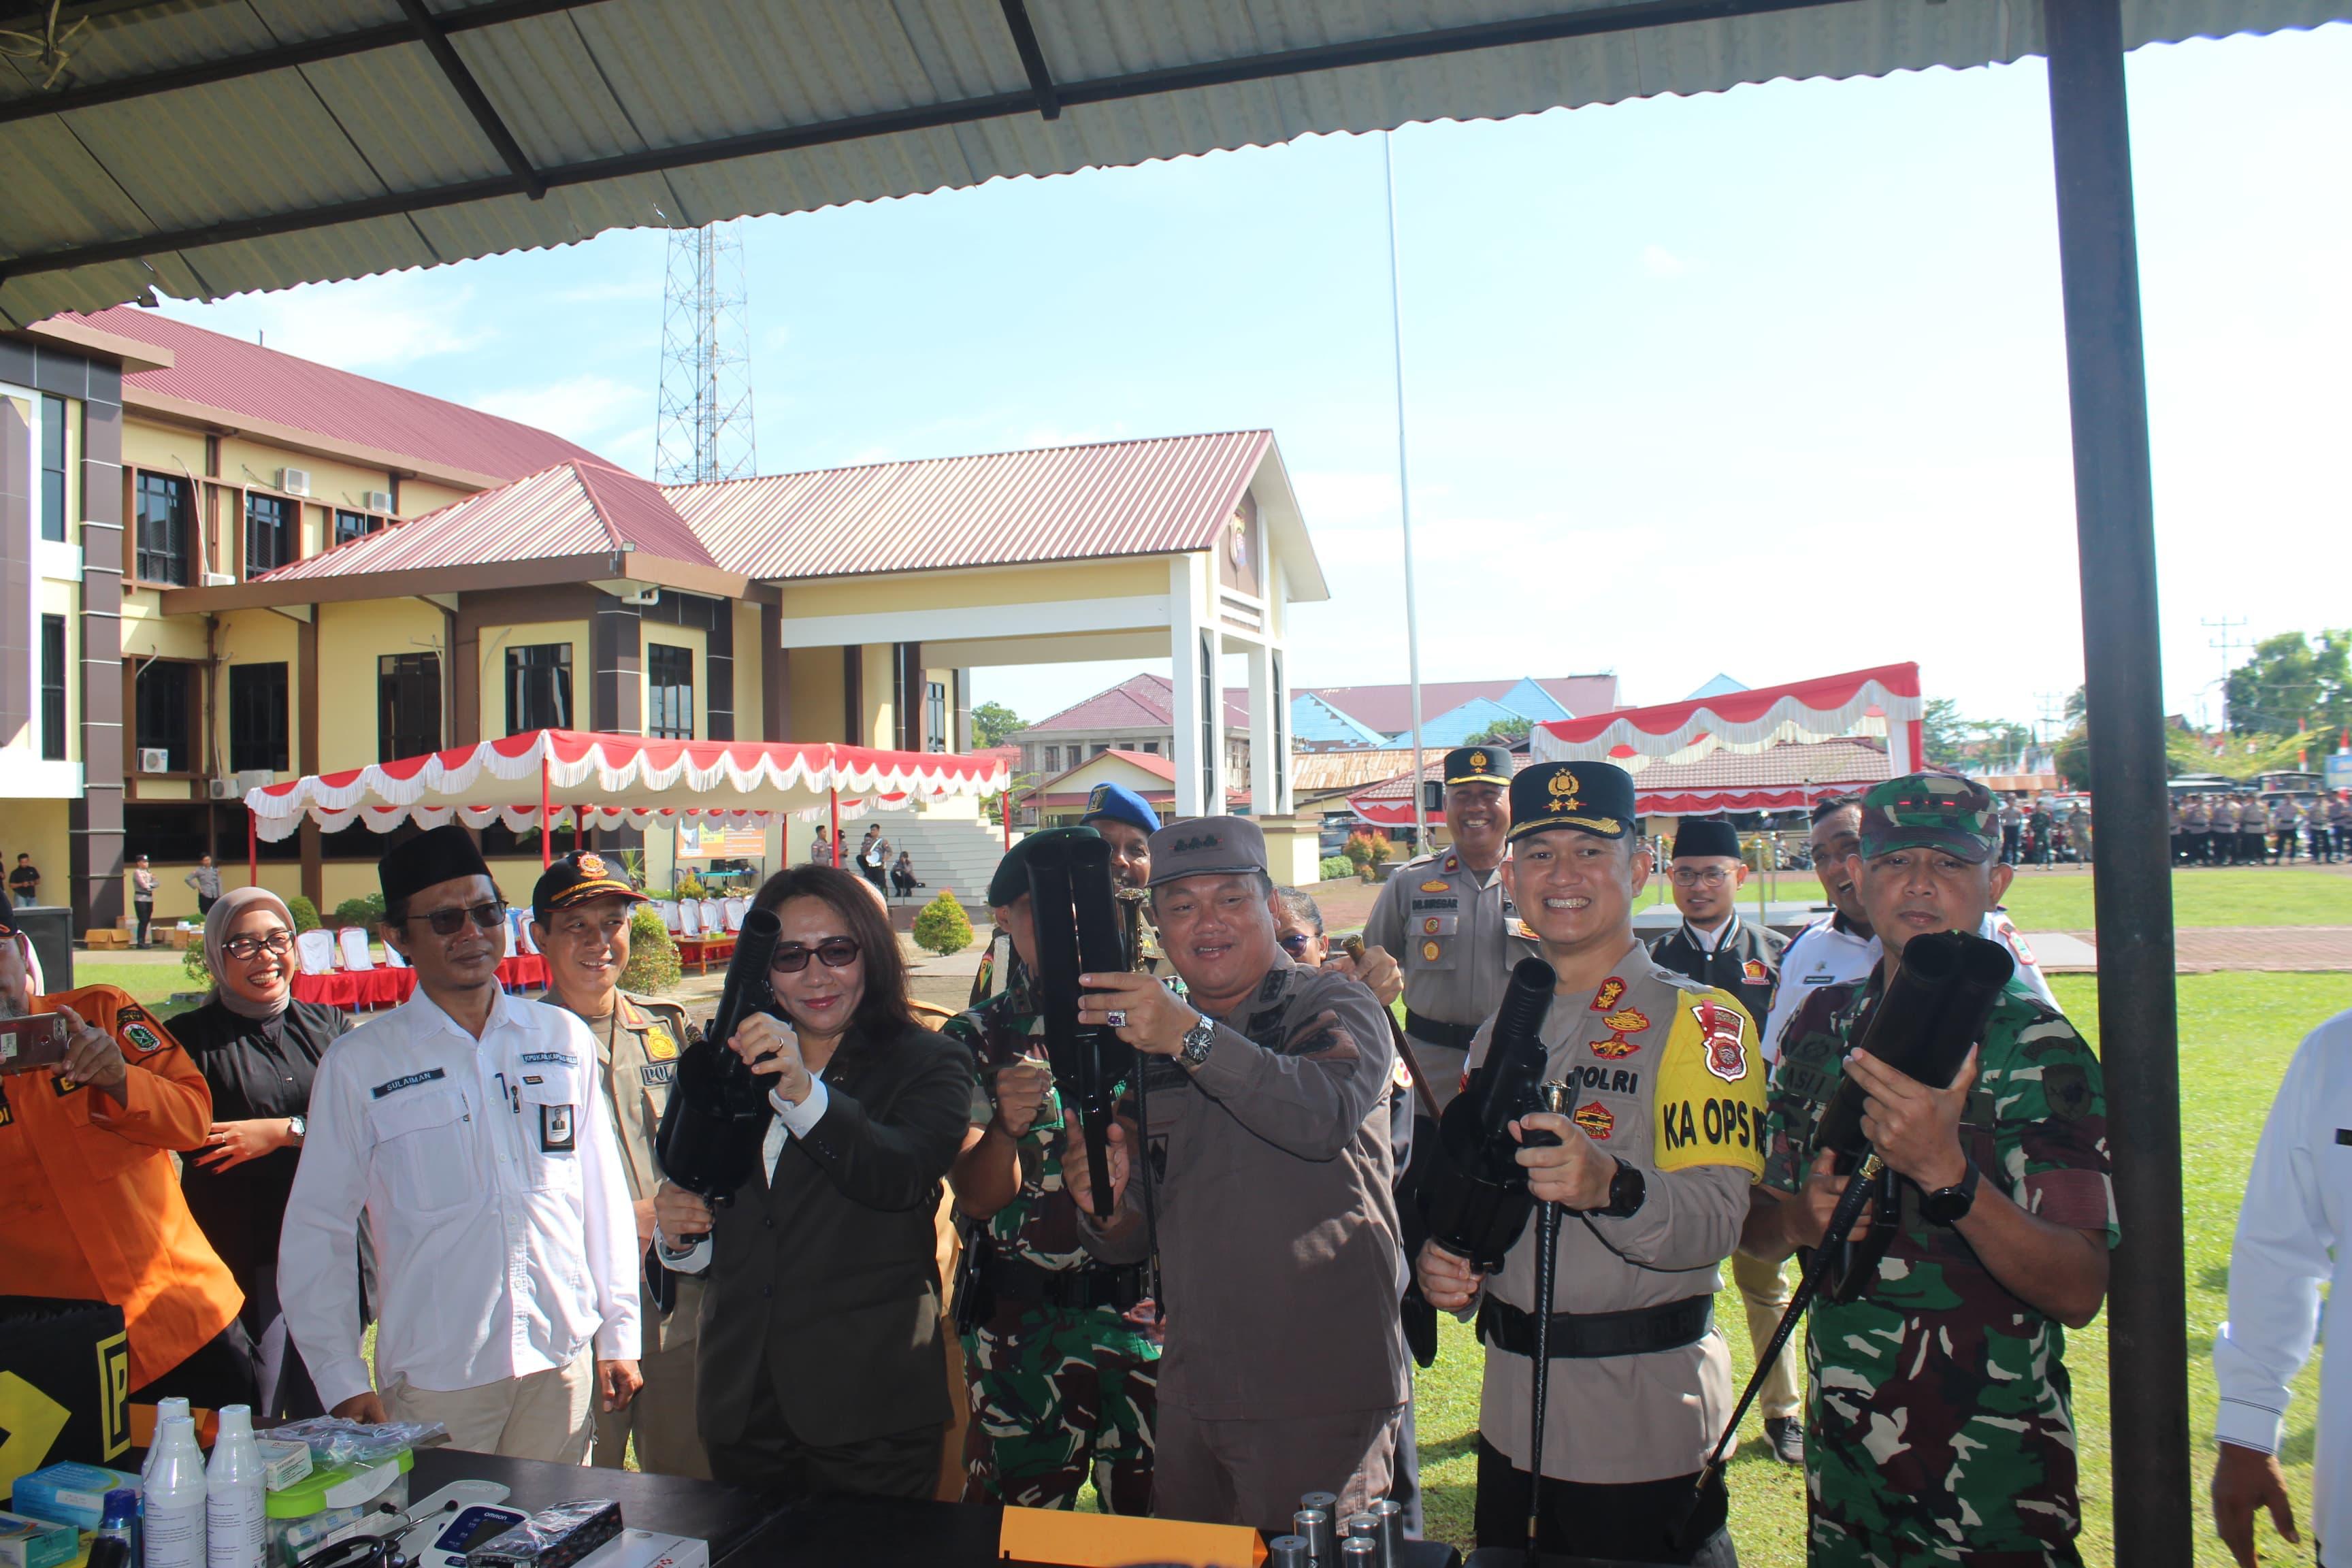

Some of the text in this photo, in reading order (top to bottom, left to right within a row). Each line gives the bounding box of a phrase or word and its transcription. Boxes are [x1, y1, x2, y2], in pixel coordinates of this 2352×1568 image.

[387, 1072, 431, 1090] SULAIMAN
[1663, 1102, 1697, 1151] KA
[1703, 1098, 1750, 1147] OPS
